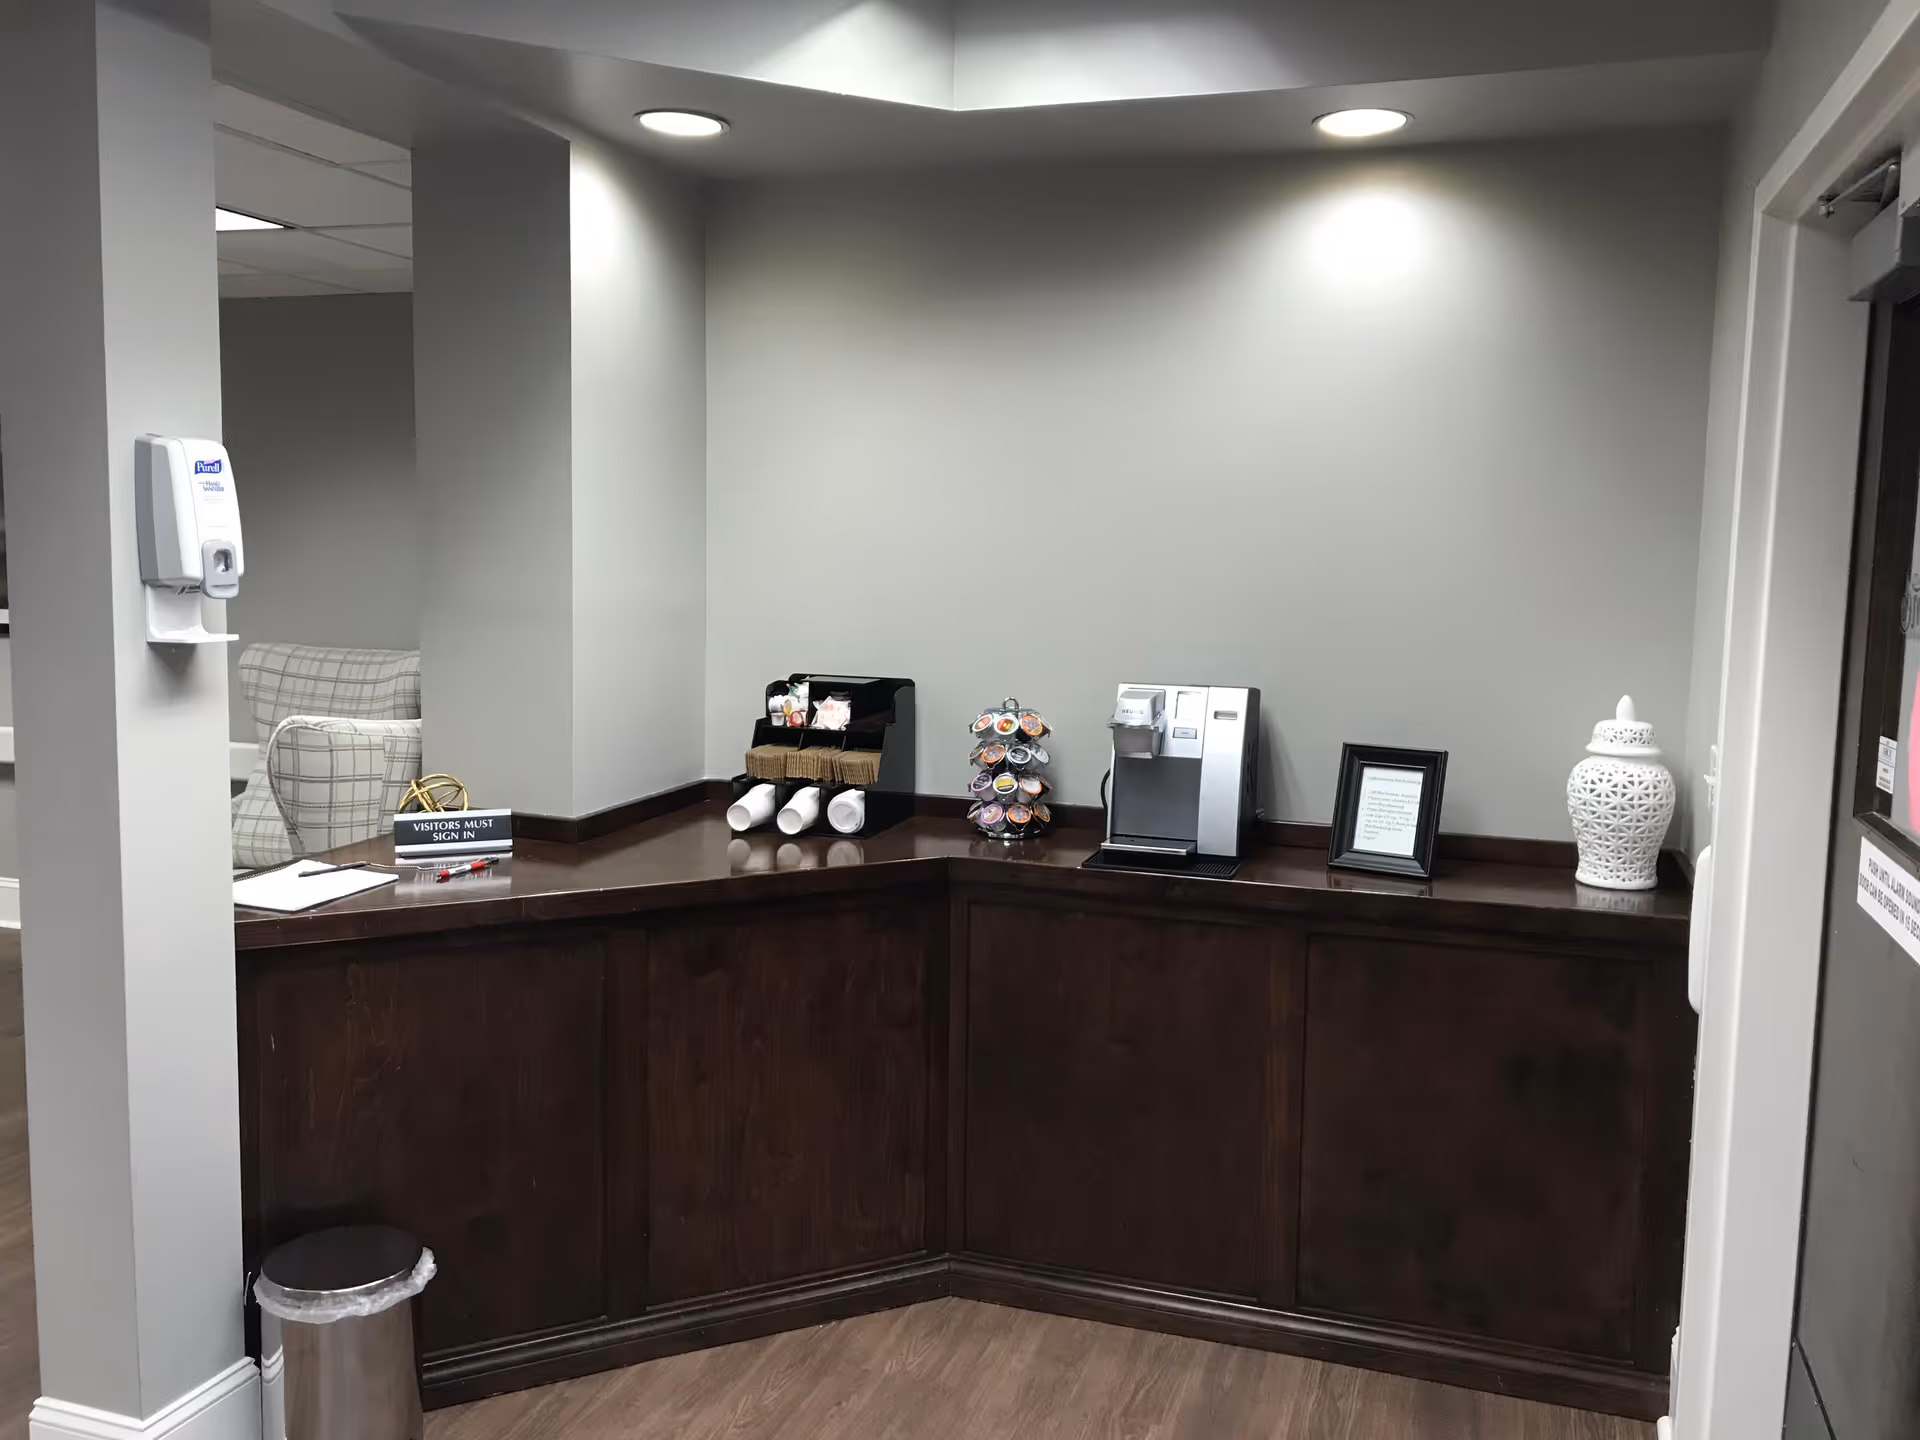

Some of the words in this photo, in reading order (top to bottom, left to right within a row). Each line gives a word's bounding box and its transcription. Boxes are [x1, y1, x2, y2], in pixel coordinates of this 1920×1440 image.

[197, 462, 220, 472] Purell
[413, 821, 461, 831] VISITORS
[464, 819, 494, 829] MUST
[433, 832, 459, 841] SIGN
[463, 831, 475, 839] IN
[1868, 857, 1879, 877] PUSH
[1879, 867, 1890, 888] UNTIL
[1890, 878, 1905, 901] ALARM
[1859, 873, 1869, 893] DOOR
[1869, 882, 1877, 900] CAN
[1877, 888, 1883, 906] BE
[1883, 894, 1899, 921] OPENED
[1899, 908, 1905, 925] IN
[1905, 914, 1911, 930] 15
